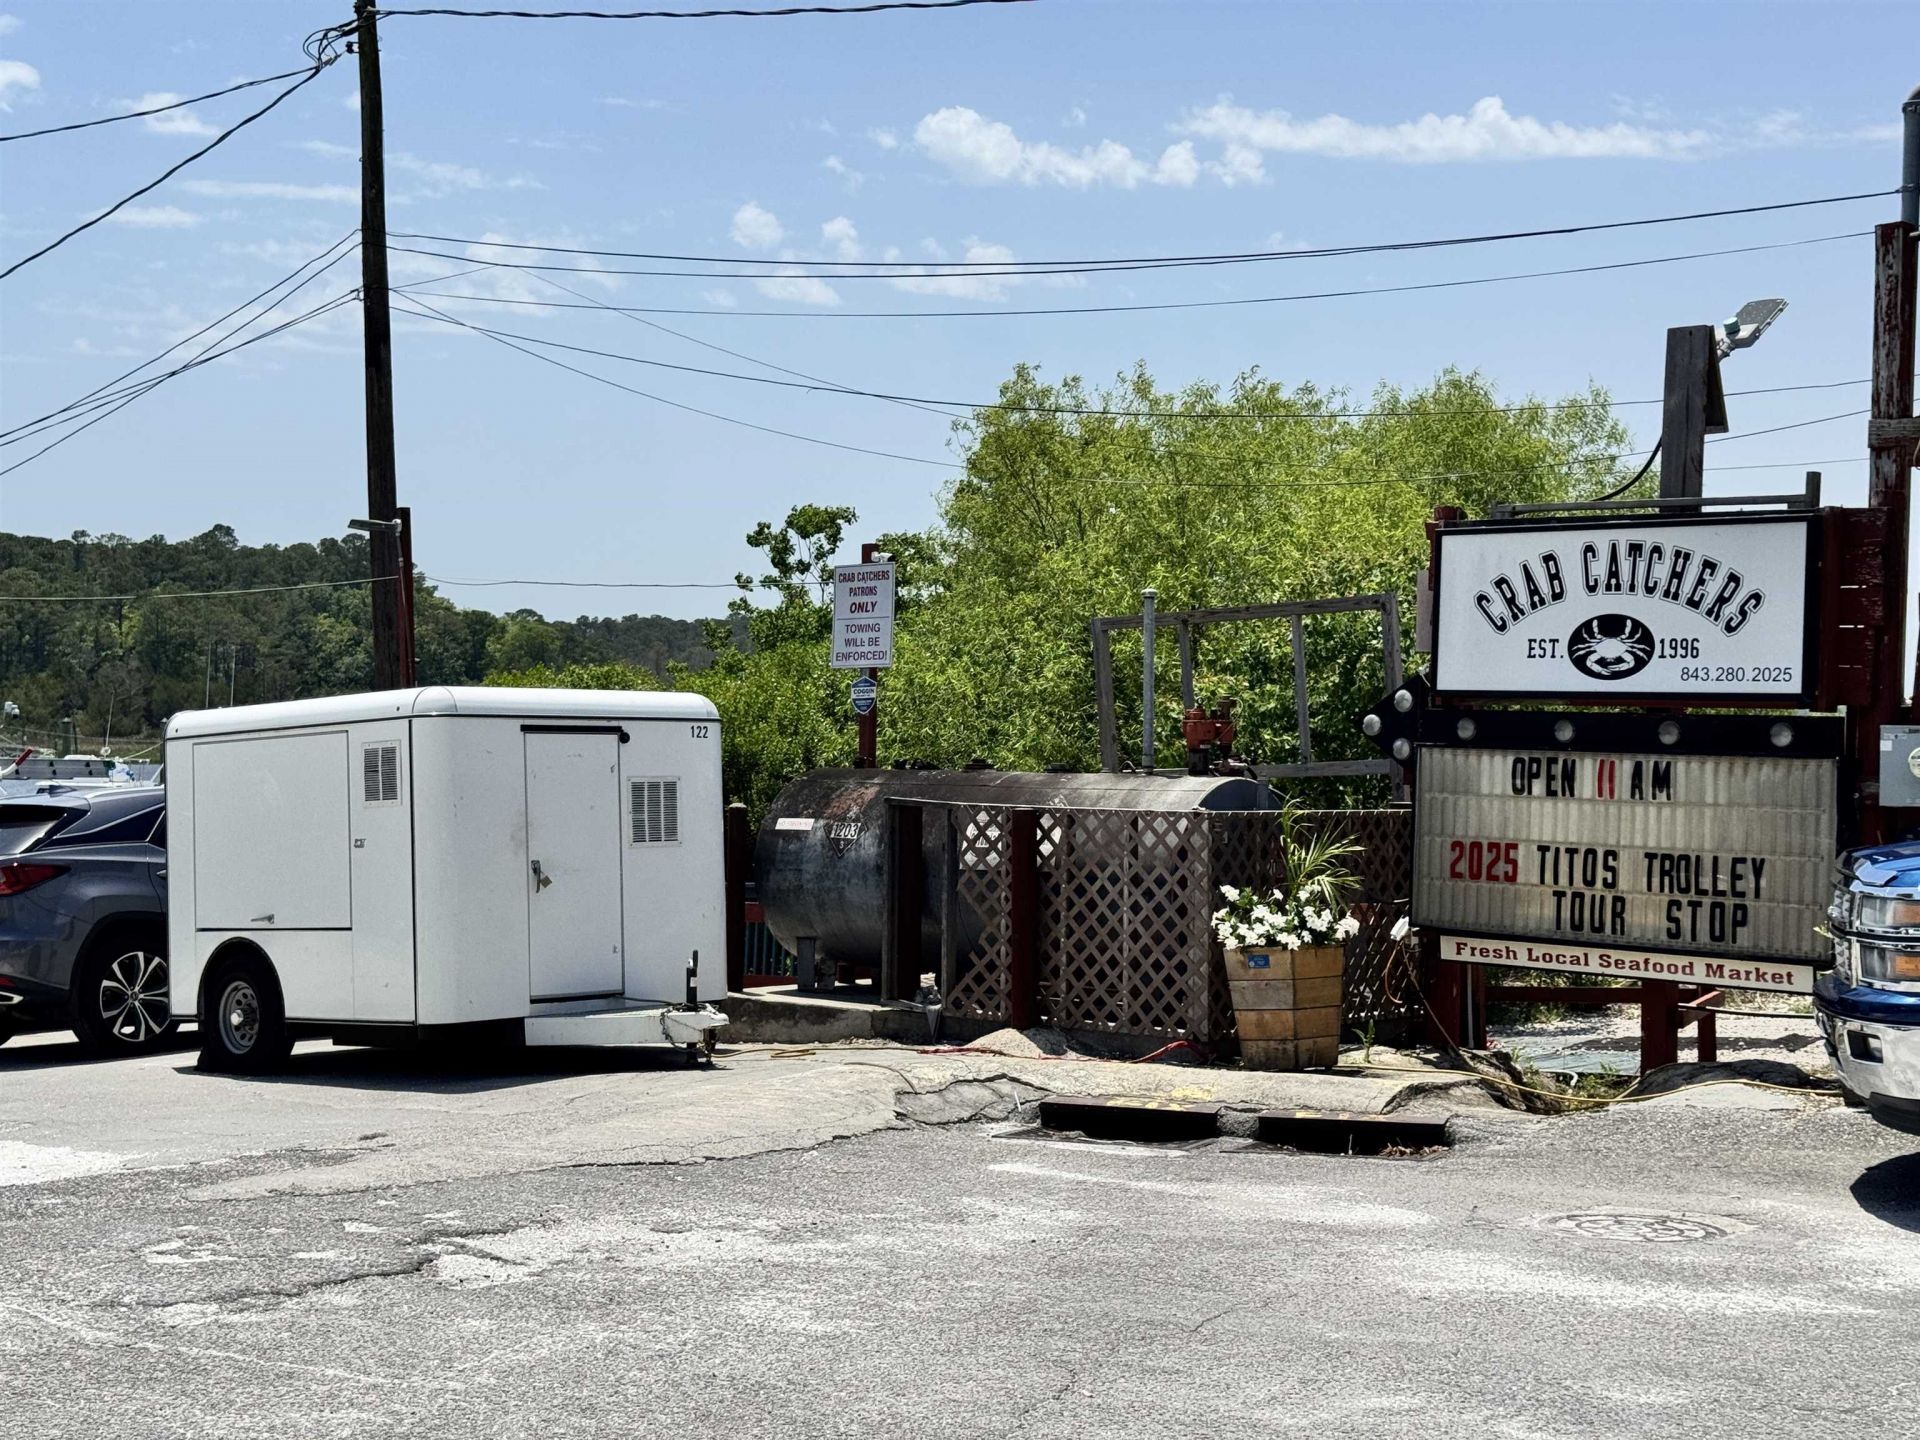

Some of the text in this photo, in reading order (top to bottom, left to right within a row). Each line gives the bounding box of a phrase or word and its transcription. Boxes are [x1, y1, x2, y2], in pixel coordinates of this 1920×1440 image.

[838, 570, 890, 583] CRAB CATCHERS
[849, 586, 878, 597] PATRONS
[1473, 539, 1766, 637] CRAB CATCHERS
[850, 601, 878, 614] ONLY
[845, 623, 881, 634] TOWING
[844, 637, 880, 648] WILL BE
[1526, 638, 1700, 659] EST. 1996
[835, 650, 888, 662] ENFORCED!
[1680, 666, 1793, 682] 843.280.2025
[690, 725, 709, 739] 122
[1511, 756, 1576, 797] OPEN
[1630, 760, 1672, 801] AM
[834, 823, 859, 838] 1203
[839, 840, 844, 849] 3
[1450, 840, 1766, 899] 2025 TITOS TROLLEY
[1552, 890, 1748, 945] TOUR STOP
[1455, 942, 1795, 986] Fresh Local Seafood Market
